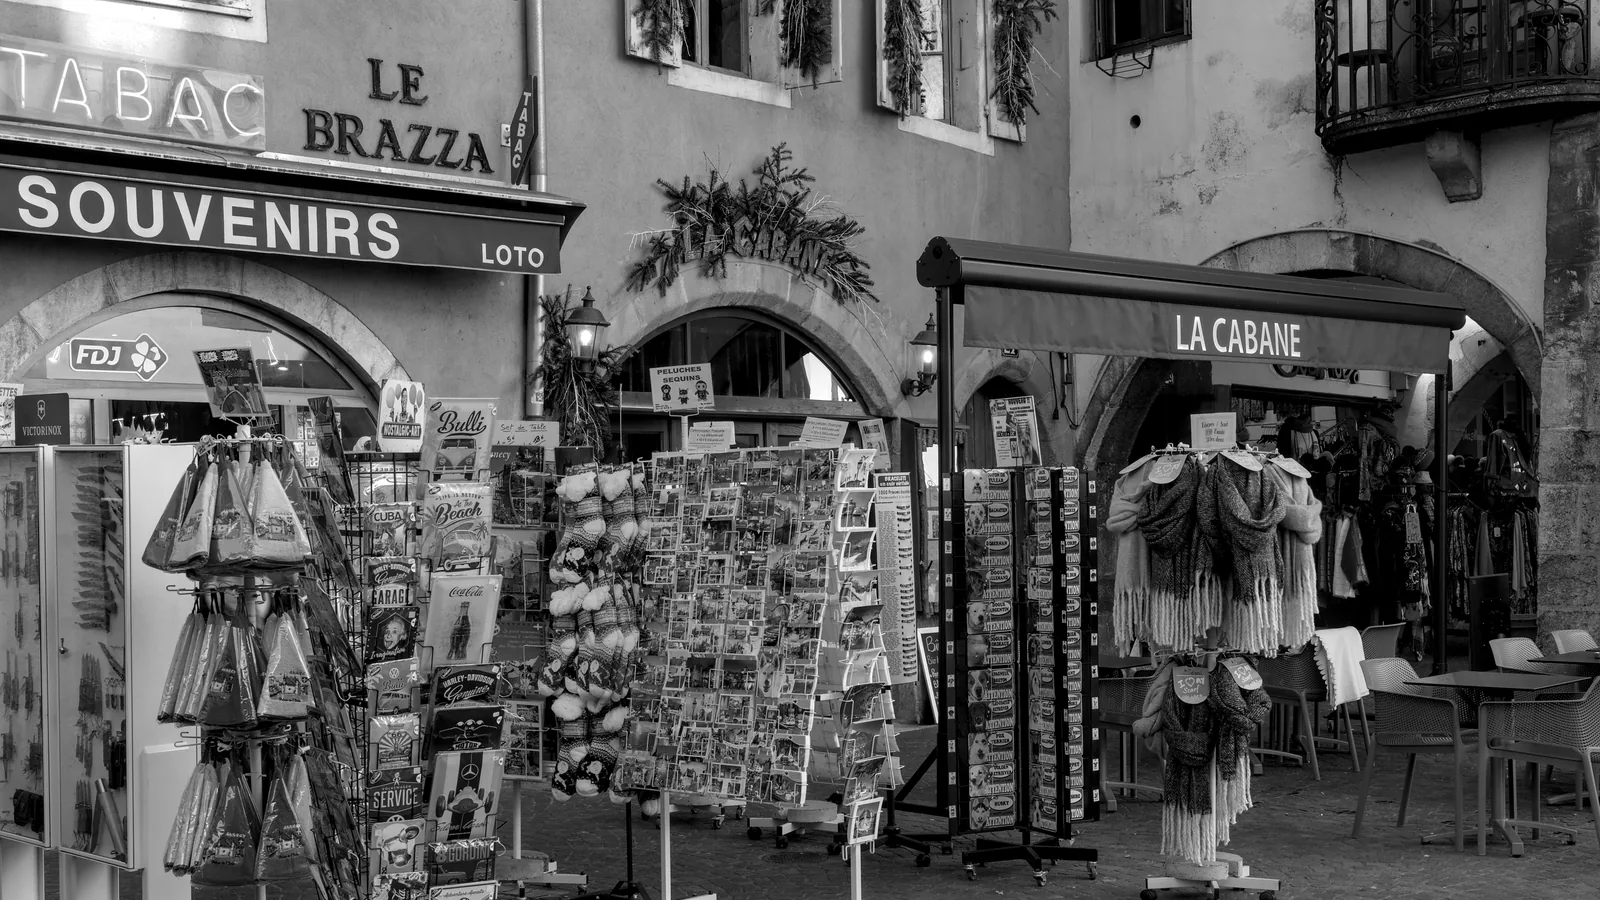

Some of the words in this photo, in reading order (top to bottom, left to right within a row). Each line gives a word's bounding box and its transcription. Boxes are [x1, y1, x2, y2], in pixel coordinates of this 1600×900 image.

[367, 57, 430, 106] LE
[0, 46, 262, 137] TABAC
[511, 91, 532, 169] TABAC
[302, 107, 494, 174] BRAZZA
[18, 175, 401, 260] SOUVENIRS
[481, 242, 545, 269] LOTO
[1176, 314, 1207, 352] LA
[1212, 317, 1301, 358] CABANE
[76, 344, 121, 366] FDJ
[657, 366, 702, 375] PELUCHES
[663, 375, 701, 383] SEQUINS
[437, 410, 486, 434] Bulli
[22, 425, 62, 436] VICTORINOX
[384, 424, 420, 437] NOSTALGIC-ART
[373, 511, 402, 521] CUBA
[435, 501, 482, 525] Beach
[981, 523, 1010, 533] ATTENTION
[980, 555, 1011, 566] ATTENTION
[982, 588, 1012, 599] ATTENTION
[983, 620, 1012, 631] ATTENTION
[983, 654, 1012, 664] ATTENTION
[442, 674, 495, 688] HARLEY-DAVIDSON
[373, 787, 419, 809] SERVICE
[986, 816, 1014, 826] ATTENTION
